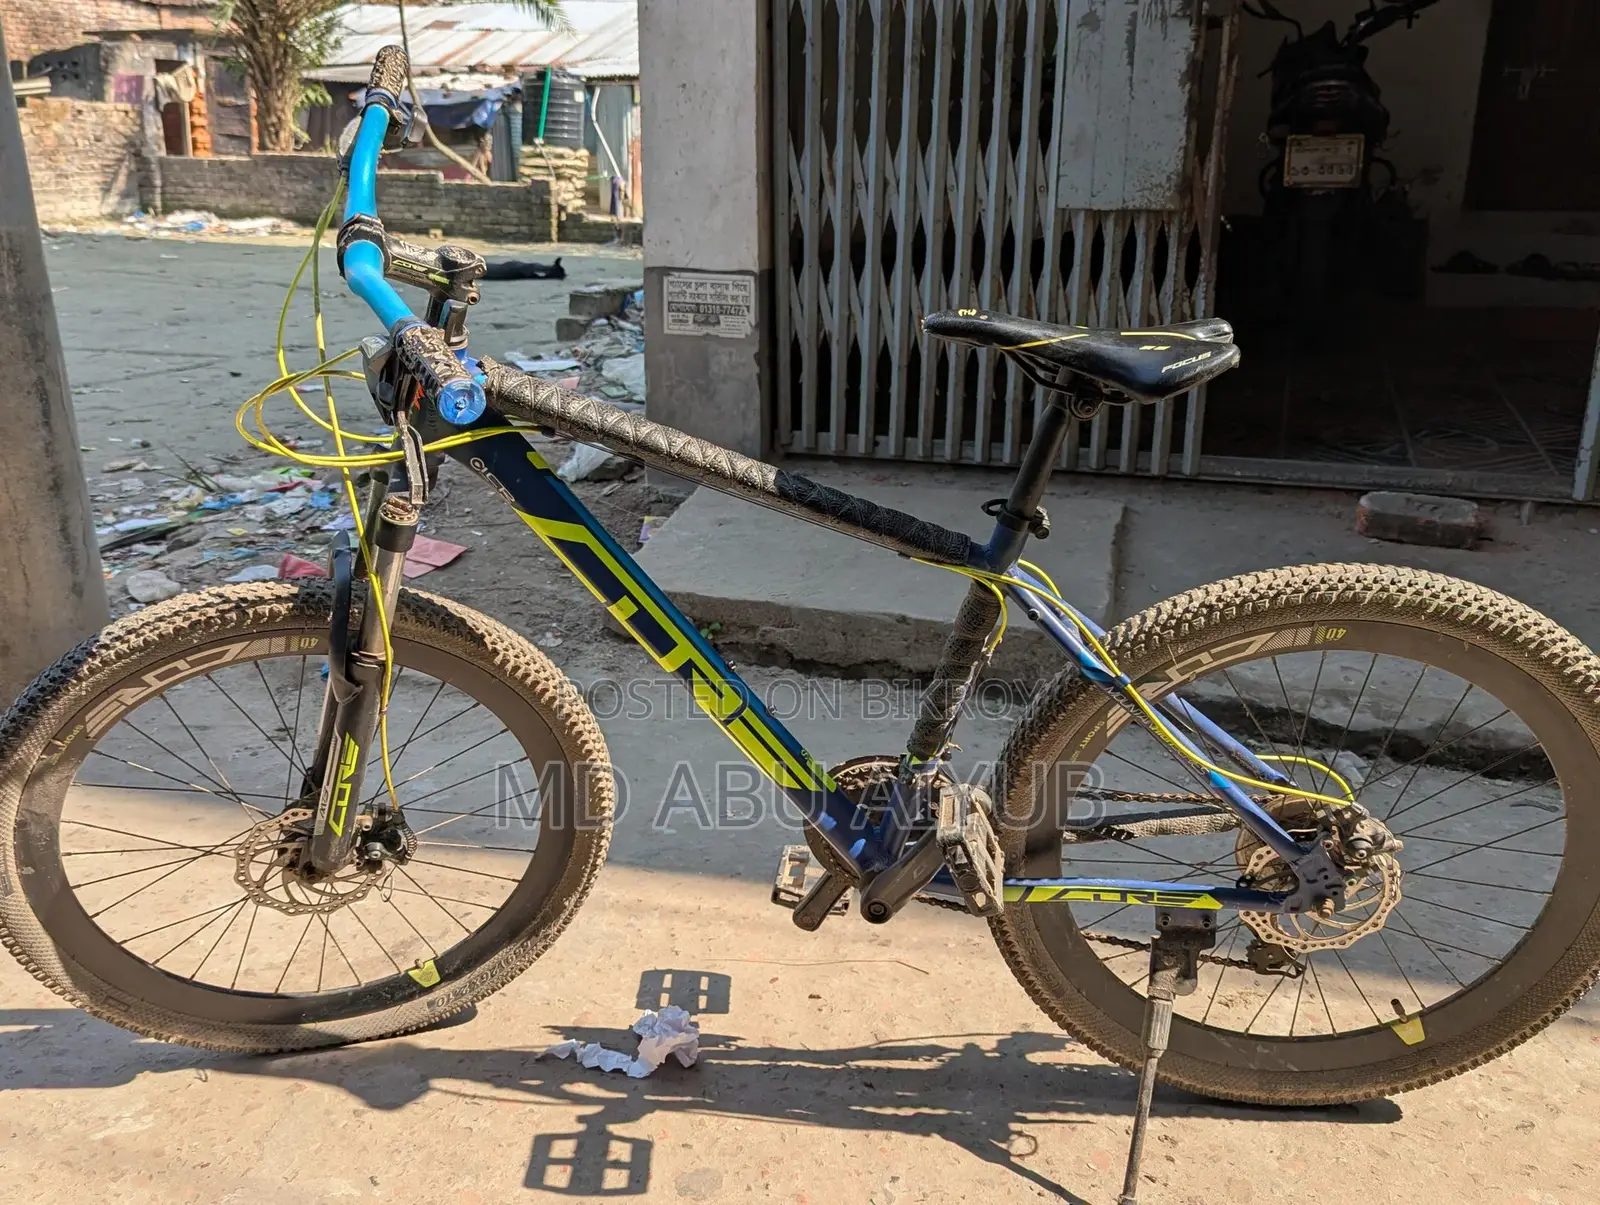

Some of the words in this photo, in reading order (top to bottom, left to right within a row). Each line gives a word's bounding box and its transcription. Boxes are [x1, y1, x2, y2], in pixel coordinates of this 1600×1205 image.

[1161, 351, 1212, 373] FOCUS
[1079, 720, 1105, 749] SPORT
[329, 732, 359, 837] CORE
